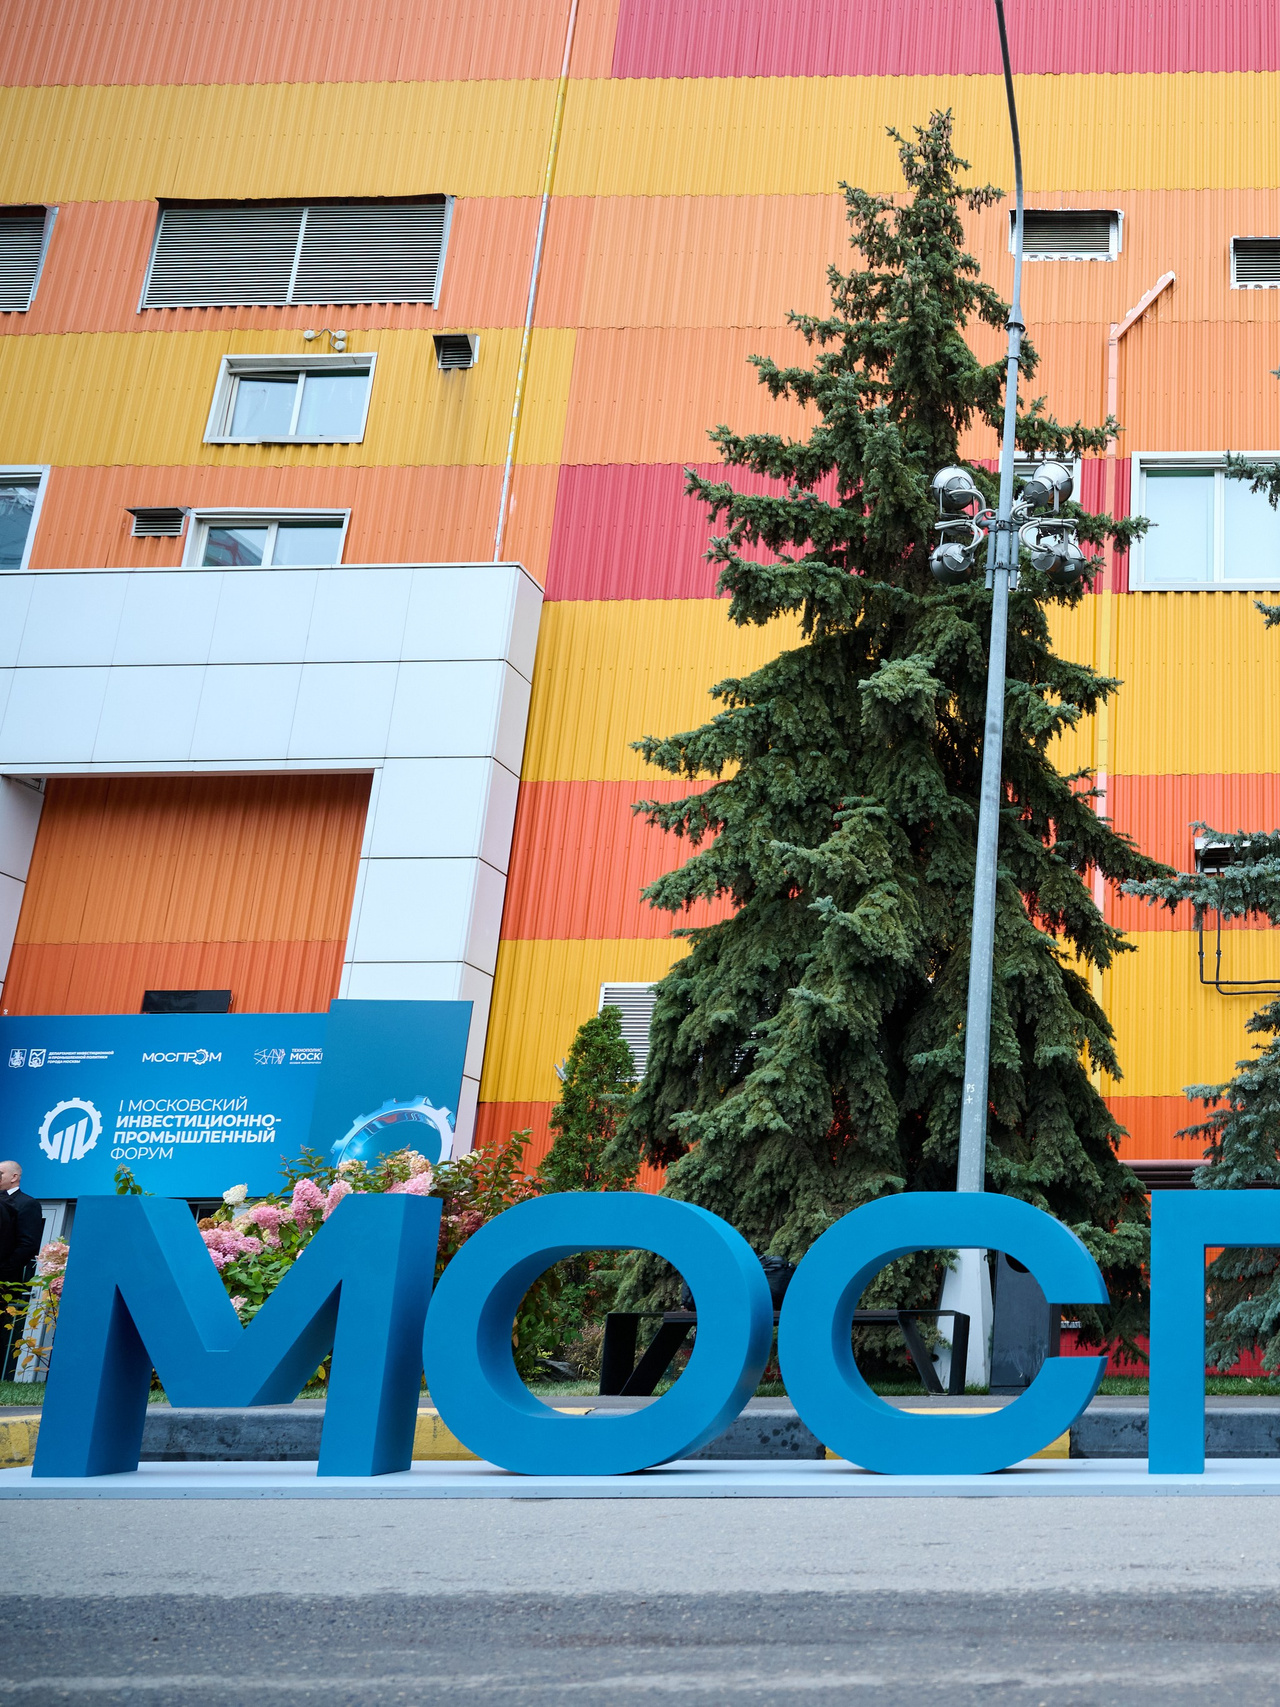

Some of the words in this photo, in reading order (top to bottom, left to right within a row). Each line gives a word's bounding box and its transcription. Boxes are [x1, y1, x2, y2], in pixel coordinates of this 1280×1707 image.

[142, 1048, 222, 1065] МОСПРОМ
[119, 1099, 124, 1112] I
[128, 1096, 248, 1112] МОСКОВСКИЙ
[116, 1114, 282, 1129] ИНВЕСТИЦИОННО-
[113, 1127, 276, 1144] ПРОМЫШЛЕННЫЙ
[110, 1147, 174, 1161] ФОРУМ
